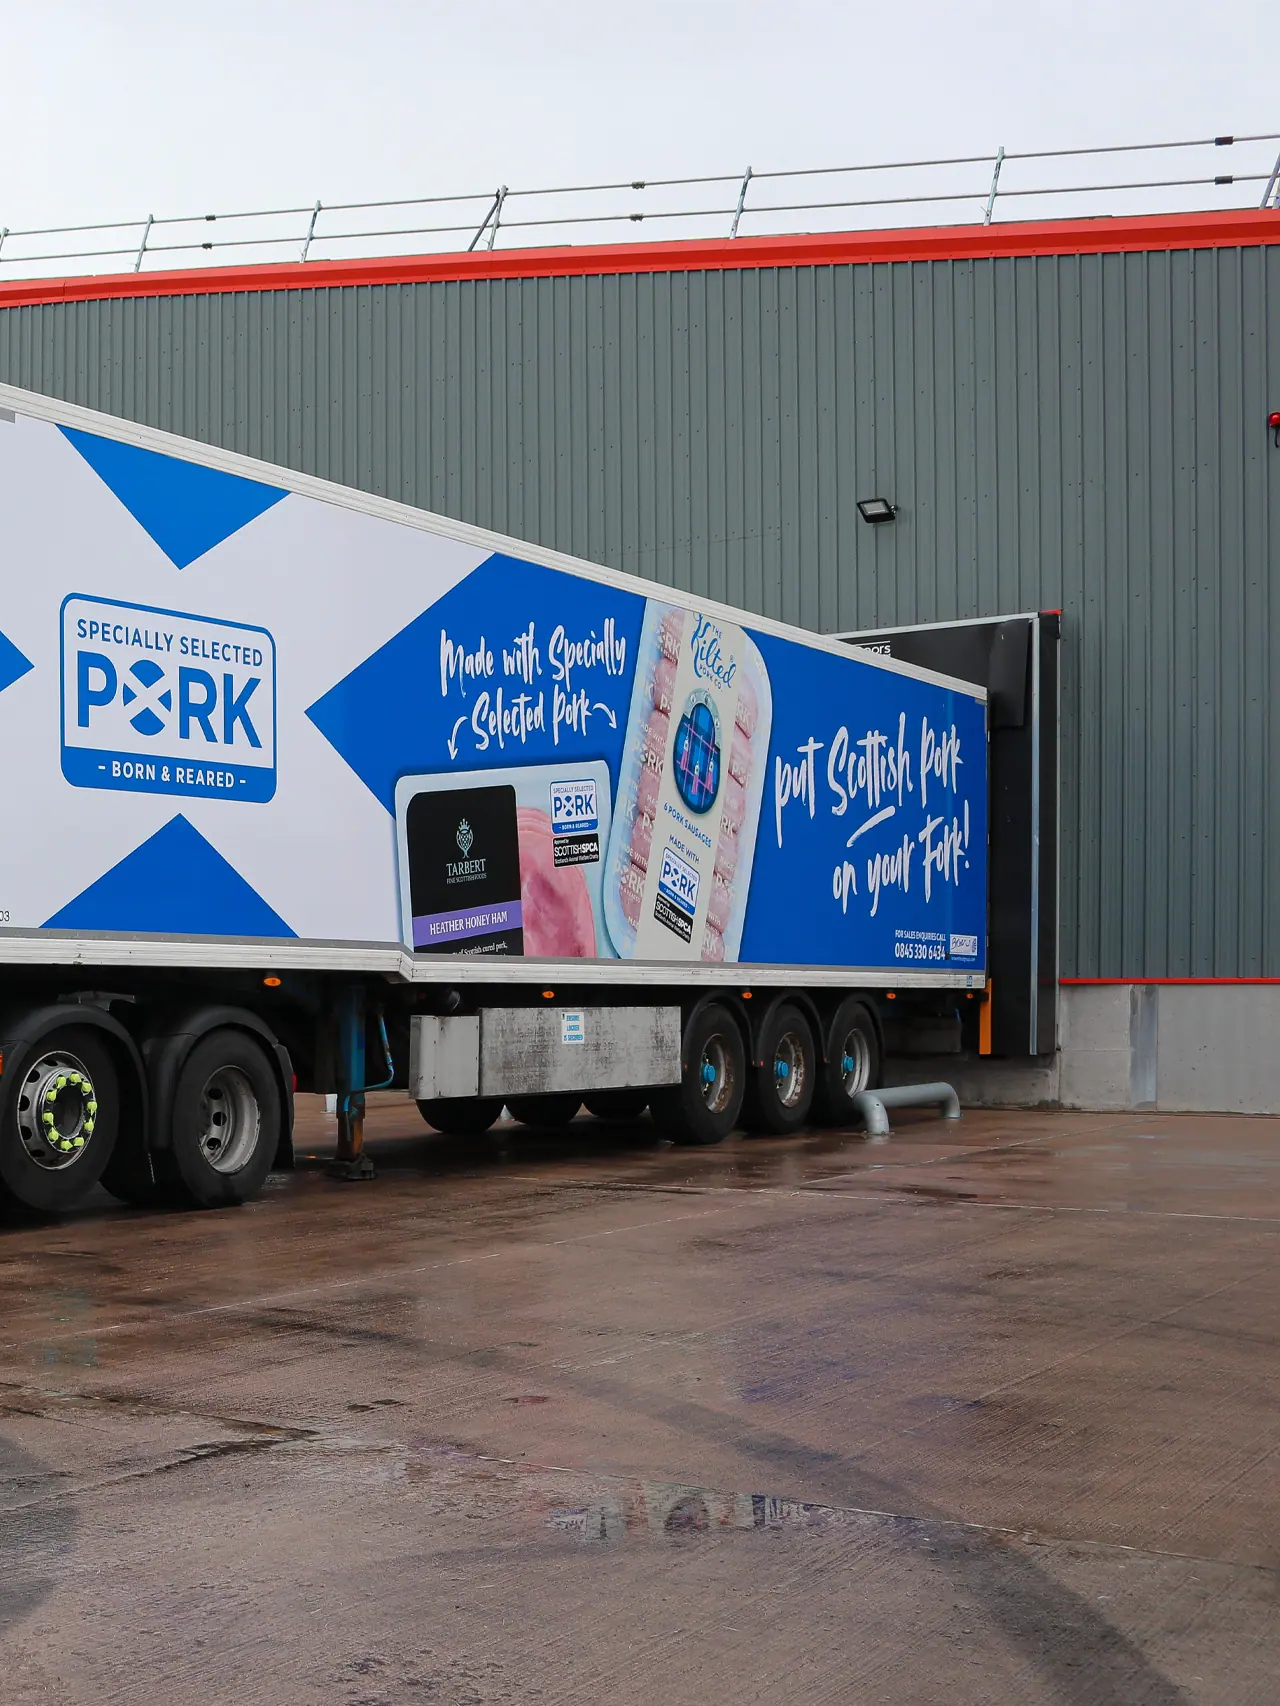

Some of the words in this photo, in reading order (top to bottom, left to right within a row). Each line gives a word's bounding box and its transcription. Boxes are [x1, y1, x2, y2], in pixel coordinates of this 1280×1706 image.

[77, 618, 173, 653] SPECIALLY
[179, 635, 263, 667] SELECTED
[712, 625, 722, 639] THE
[440, 629, 494, 697] Made
[502, 621, 542, 684] with
[548, 617, 626, 692] Specially
[76, 650, 263, 749] PORK
[472, 687, 546, 751] Selected
[112, 760, 156, 781] BORN
[161, 765, 172, 782] &
[176, 767, 234, 788] REARED
[827, 711, 913, 816] Scottish
[553, 793, 594, 818] PORK
[664, 803, 668, 811] 6
[669, 807, 684, 825] PORK
[684, 820, 712, 848] SAUSAGES
[669, 834, 685, 852] MADE
[686, 849, 700, 863] WITH
[446, 858, 486, 876] TARBERT
[832, 860, 858, 915] on
[868, 834, 915, 917] your
[430, 918, 464, 935] HEATHER
[465, 913, 490, 929] HONEY
[491, 910, 508, 924] HAM
[895, 929, 904, 938] FOR
[904, 930, 915, 939] SALES
[916, 931, 936, 942] ENQUIRIES
[936, 933, 946, 941] CALL
[894, 942, 913, 958] 0845
[914, 943, 927, 959] 330
[928, 945, 946, 960] 6434
